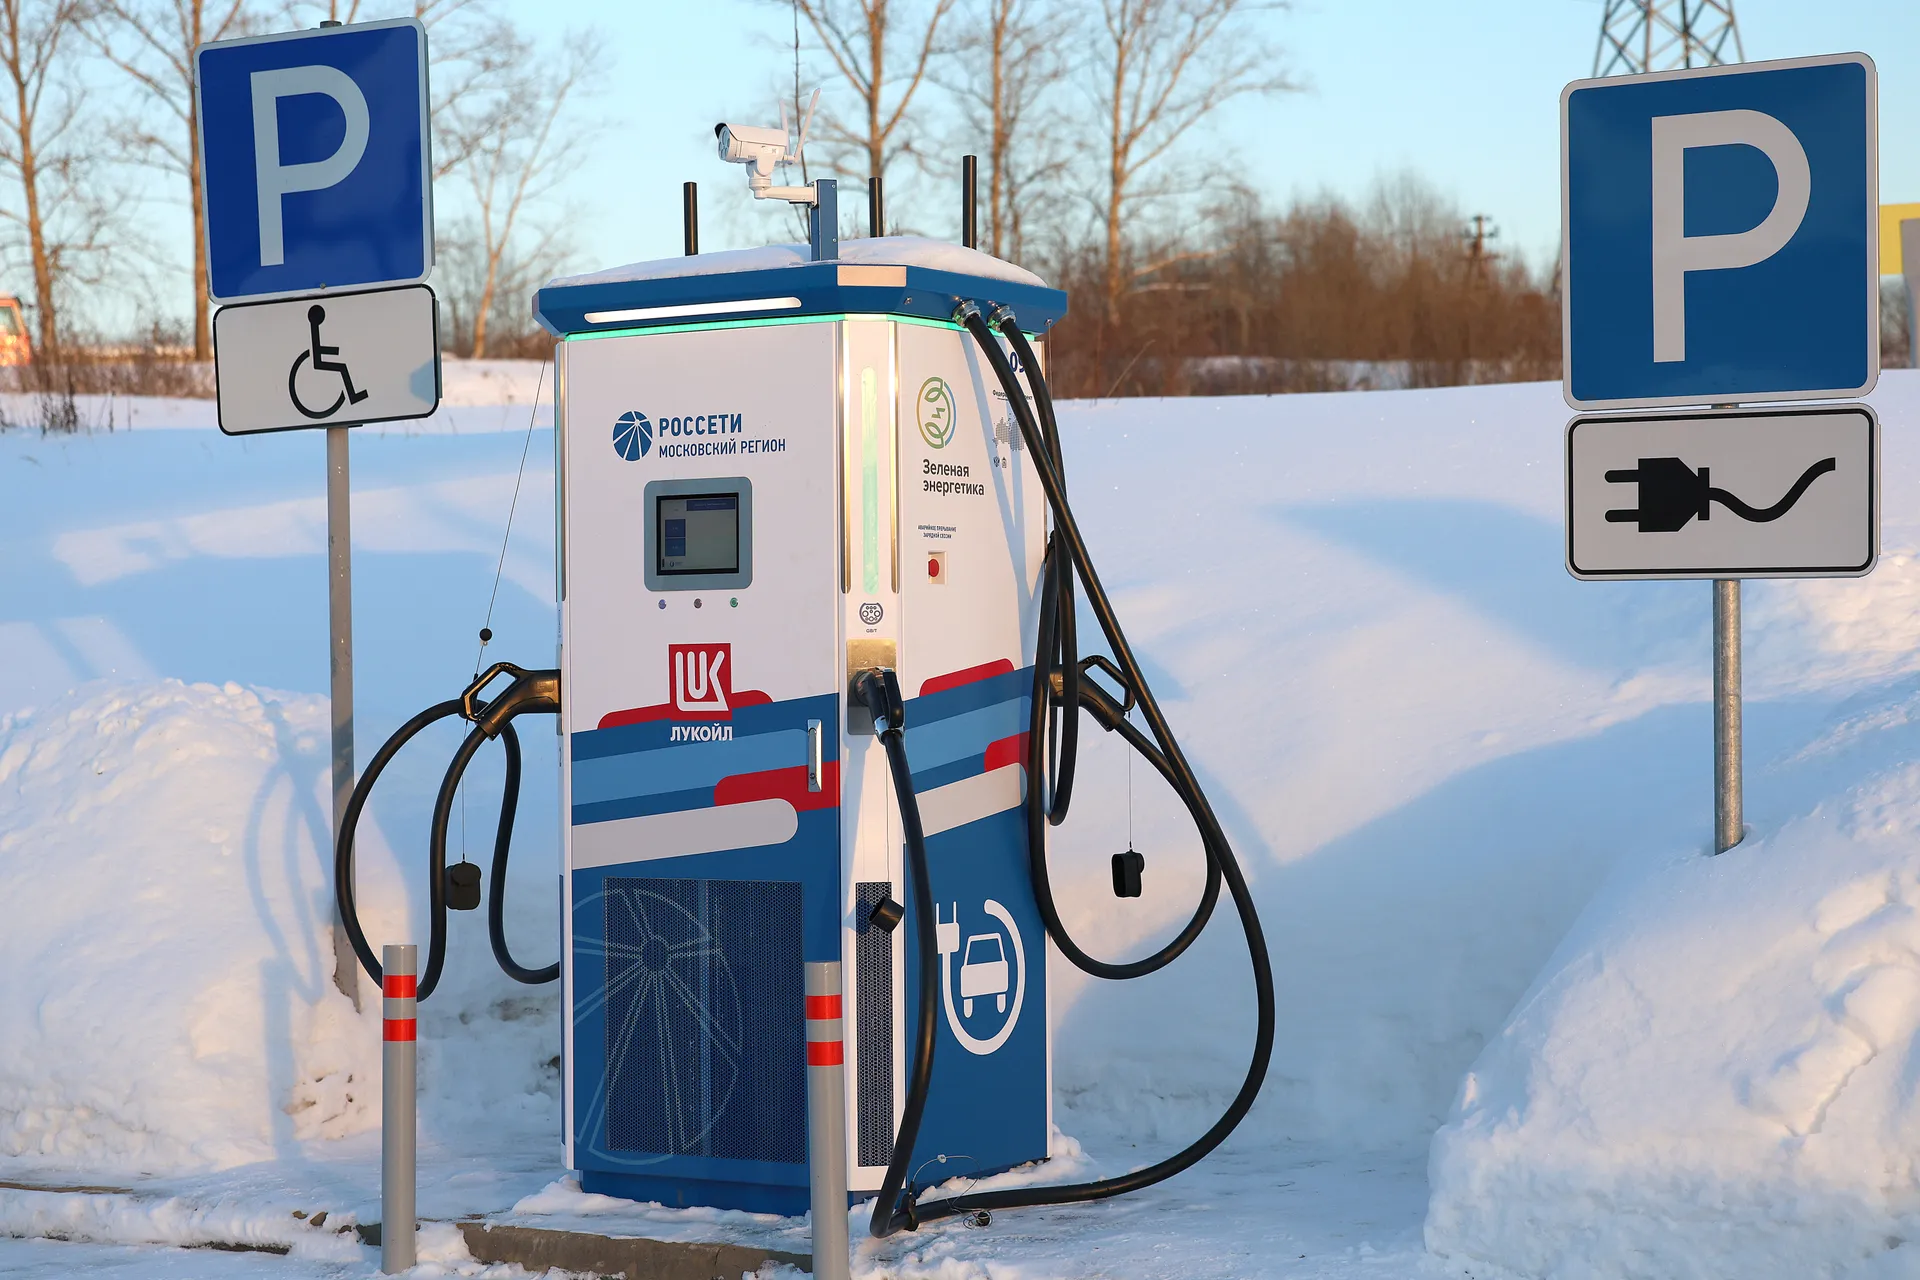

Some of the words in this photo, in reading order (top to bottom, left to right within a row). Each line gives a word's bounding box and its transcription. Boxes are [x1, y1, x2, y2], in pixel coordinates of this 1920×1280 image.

[250, 64, 370, 267] P
[1651, 109, 1811, 363] P
[659, 413, 742, 437] РОССЕТИ
[659, 438, 736, 458] МОСКОВСКИЙ
[740, 438, 786, 454] РЕГИОН
[923, 459, 970, 477] Зеленая
[923, 480, 985, 496] энергетика
[670, 723, 733, 741] ЛУКОЙЛ
